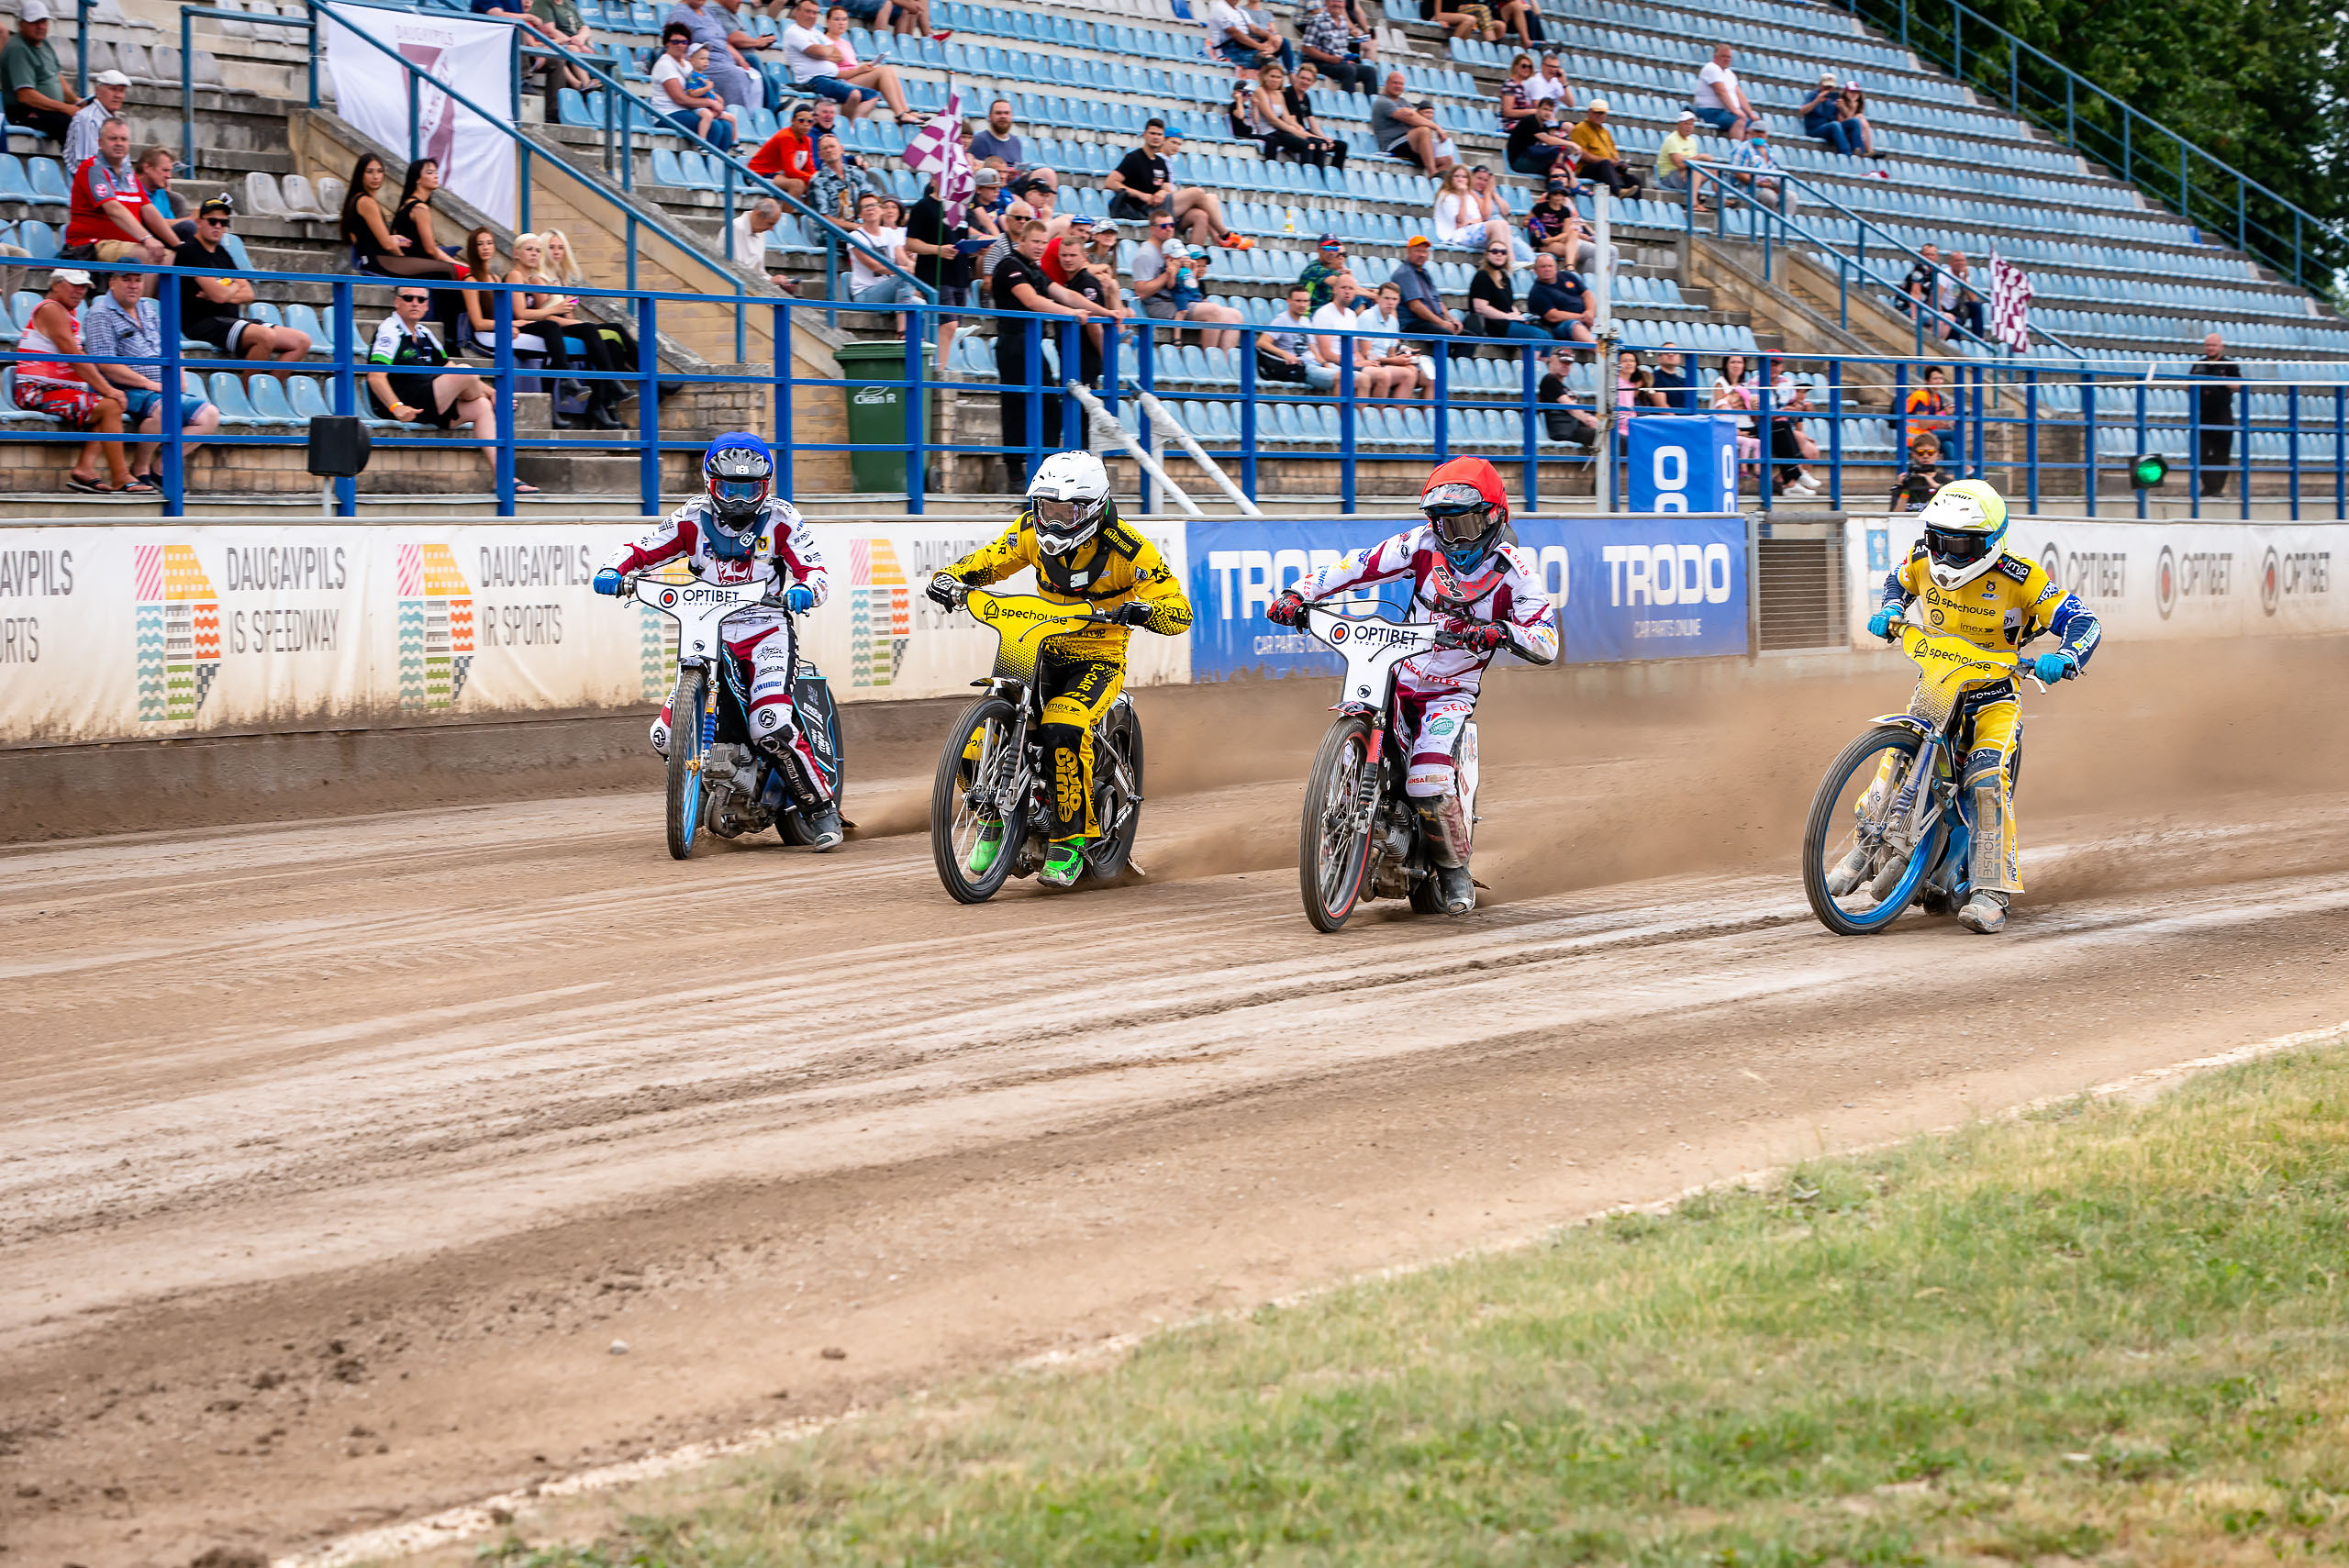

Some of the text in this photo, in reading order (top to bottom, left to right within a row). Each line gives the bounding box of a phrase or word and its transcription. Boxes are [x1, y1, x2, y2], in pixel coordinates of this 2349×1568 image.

[228, 546, 346, 591] DAUGAVPILS
[480, 544, 591, 587] DAUGAVPILS
[1601, 542, 1731, 607] TRODO
[2065, 550, 2128, 598] OPTIBET
[2180, 551, 2234, 596] OPTIBET
[2282, 550, 2332, 595] OPTIBET
[683, 589, 740, 603] OPTIBET
[1001, 606, 1068, 626] spechouse
[1941, 596, 1997, 617] spechouse
[0, 616, 40, 663] RTS
[229, 608, 340, 654] IS SPEEDWAY
[502, 603, 562, 646] SPORTS
[1354, 625, 1419, 646] OPTIBET
[1929, 647, 1991, 672] spechouse
